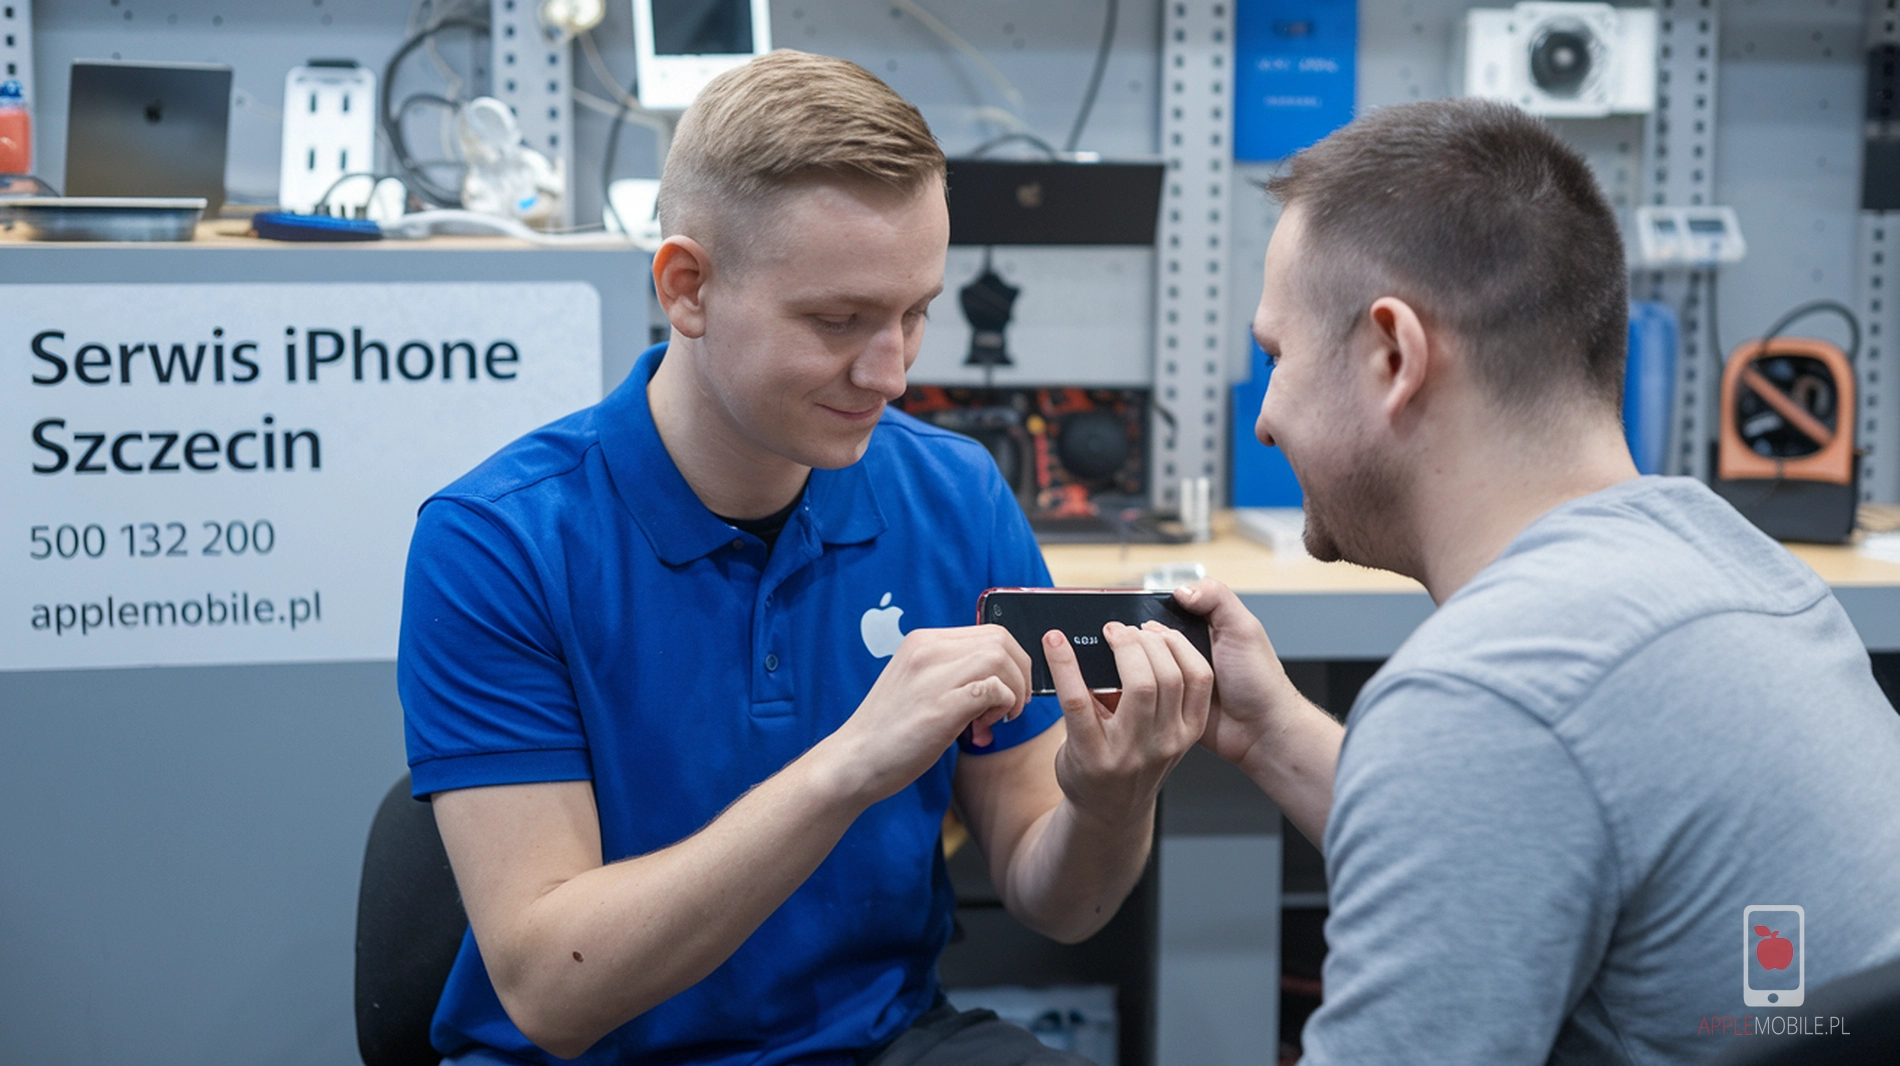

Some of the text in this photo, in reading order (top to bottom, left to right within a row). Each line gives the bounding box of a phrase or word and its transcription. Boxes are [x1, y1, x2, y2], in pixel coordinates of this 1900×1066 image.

[30, 326, 520, 387] Serwis iPhone
[31, 415, 322, 475] Szczecin
[30, 520, 275, 560] 500 132 200
[31, 590, 322, 636] applemobile.pl
